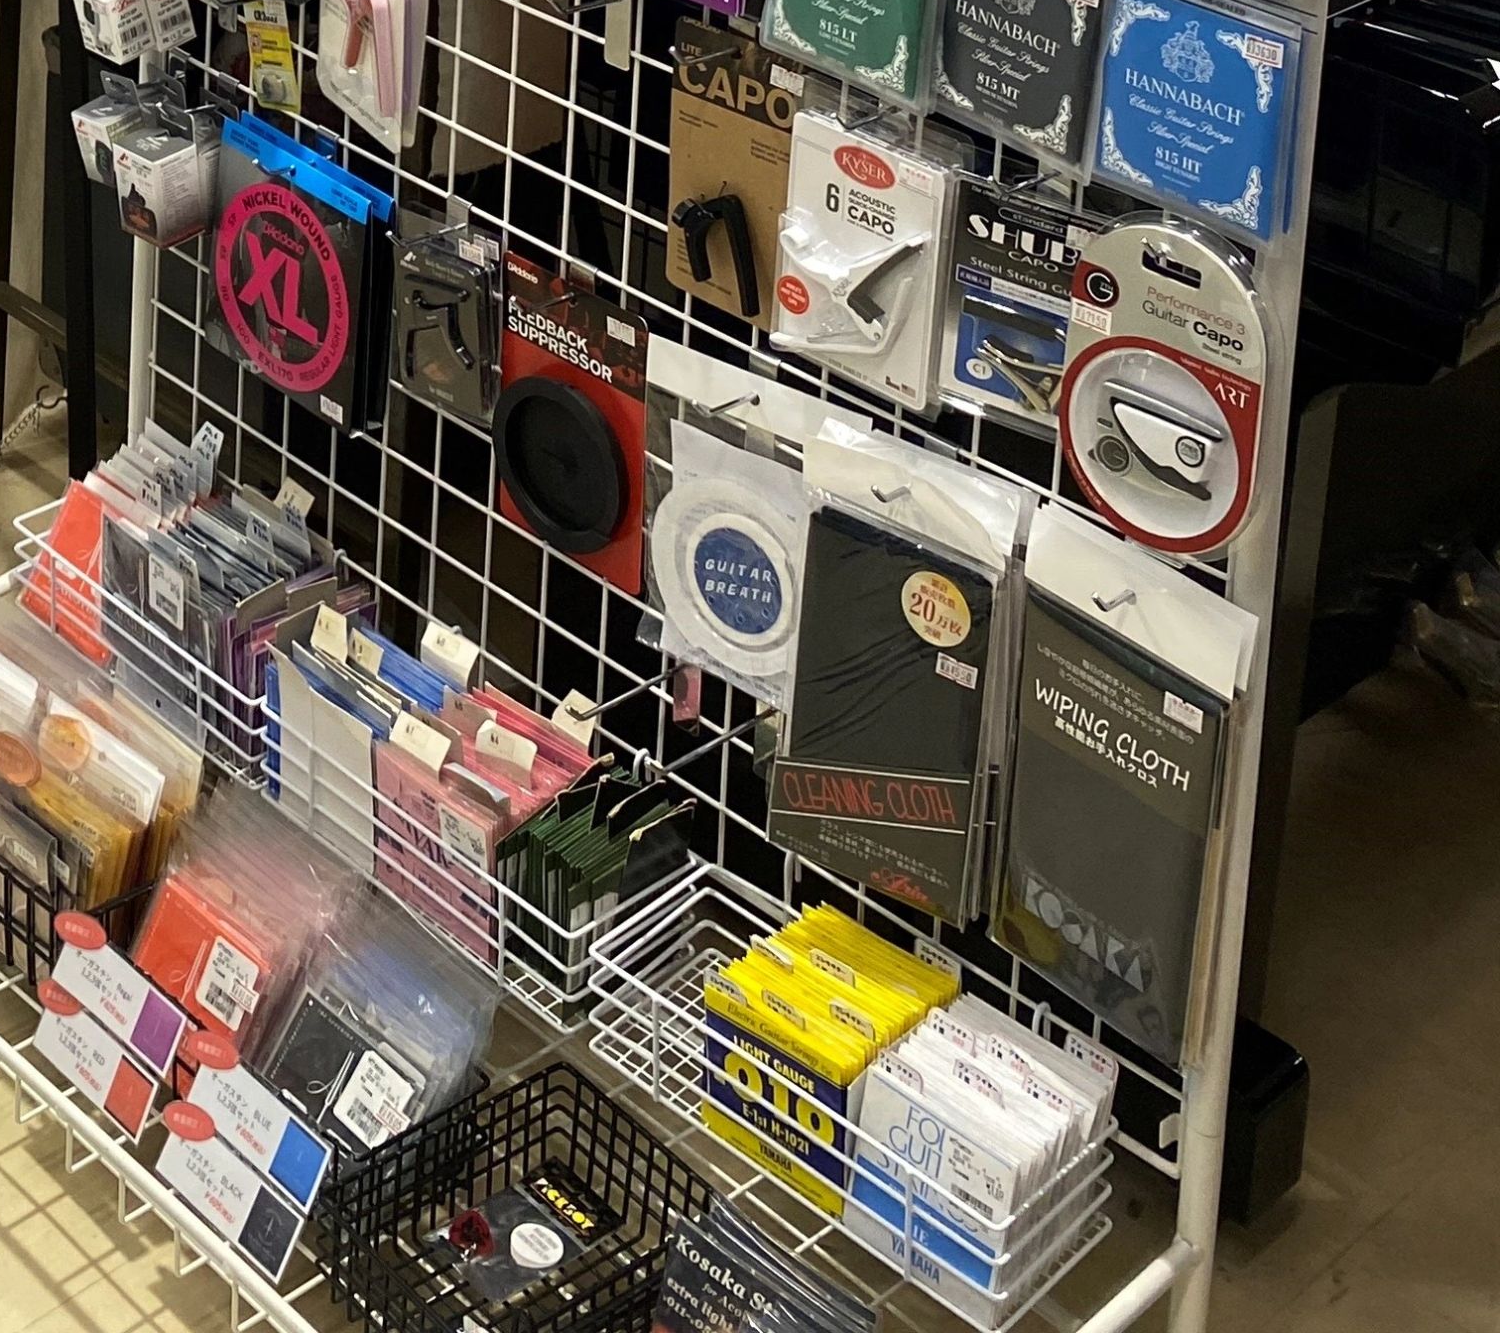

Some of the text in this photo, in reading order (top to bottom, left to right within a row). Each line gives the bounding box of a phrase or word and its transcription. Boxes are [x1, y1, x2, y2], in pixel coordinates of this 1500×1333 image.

[819, 18, 857, 44] 815 LT
[681, 42, 701, 57] LITE
[678, 56, 796, 129] CAPO
[976, 72, 1020, 101] 815 MT
[1126, 68, 1241, 126] HANNABACH
[842, 151, 889, 183] KYSER
[1155, 146, 1202, 174] 815 HT
[826, 183, 839, 213] 6
[848, 206, 895, 236] CAPO
[1012, 212, 1064, 234] standard
[238, 230, 318, 345] XL
[332, 274, 343, 319] GAUGE
[1147, 286, 1245, 334] Performance 3
[330, 325, 342, 357] LIGHT
[1142, 300, 1244, 352] Guitar Capo
[508, 316, 612, 383] SUPPRESSOR
[1202, 342, 1242, 365] Steel string
[257, 350, 293, 381] EXL170
[971, 362, 988, 377] C1
[704, 558, 774, 584] GUITAR
[704, 578, 774, 605] BREATH
[1036, 678, 1110, 743] WIPING
[1116, 733, 1190, 791] CLOTH
[783, 771, 956, 824] CLEANING CLOTH
[93, 1051, 105, 1066] RED
[254, 1109, 272, 1132] BLUE
[221, 1176, 244, 1200] BLACK
[667, 1277, 733, 1331] extra light
